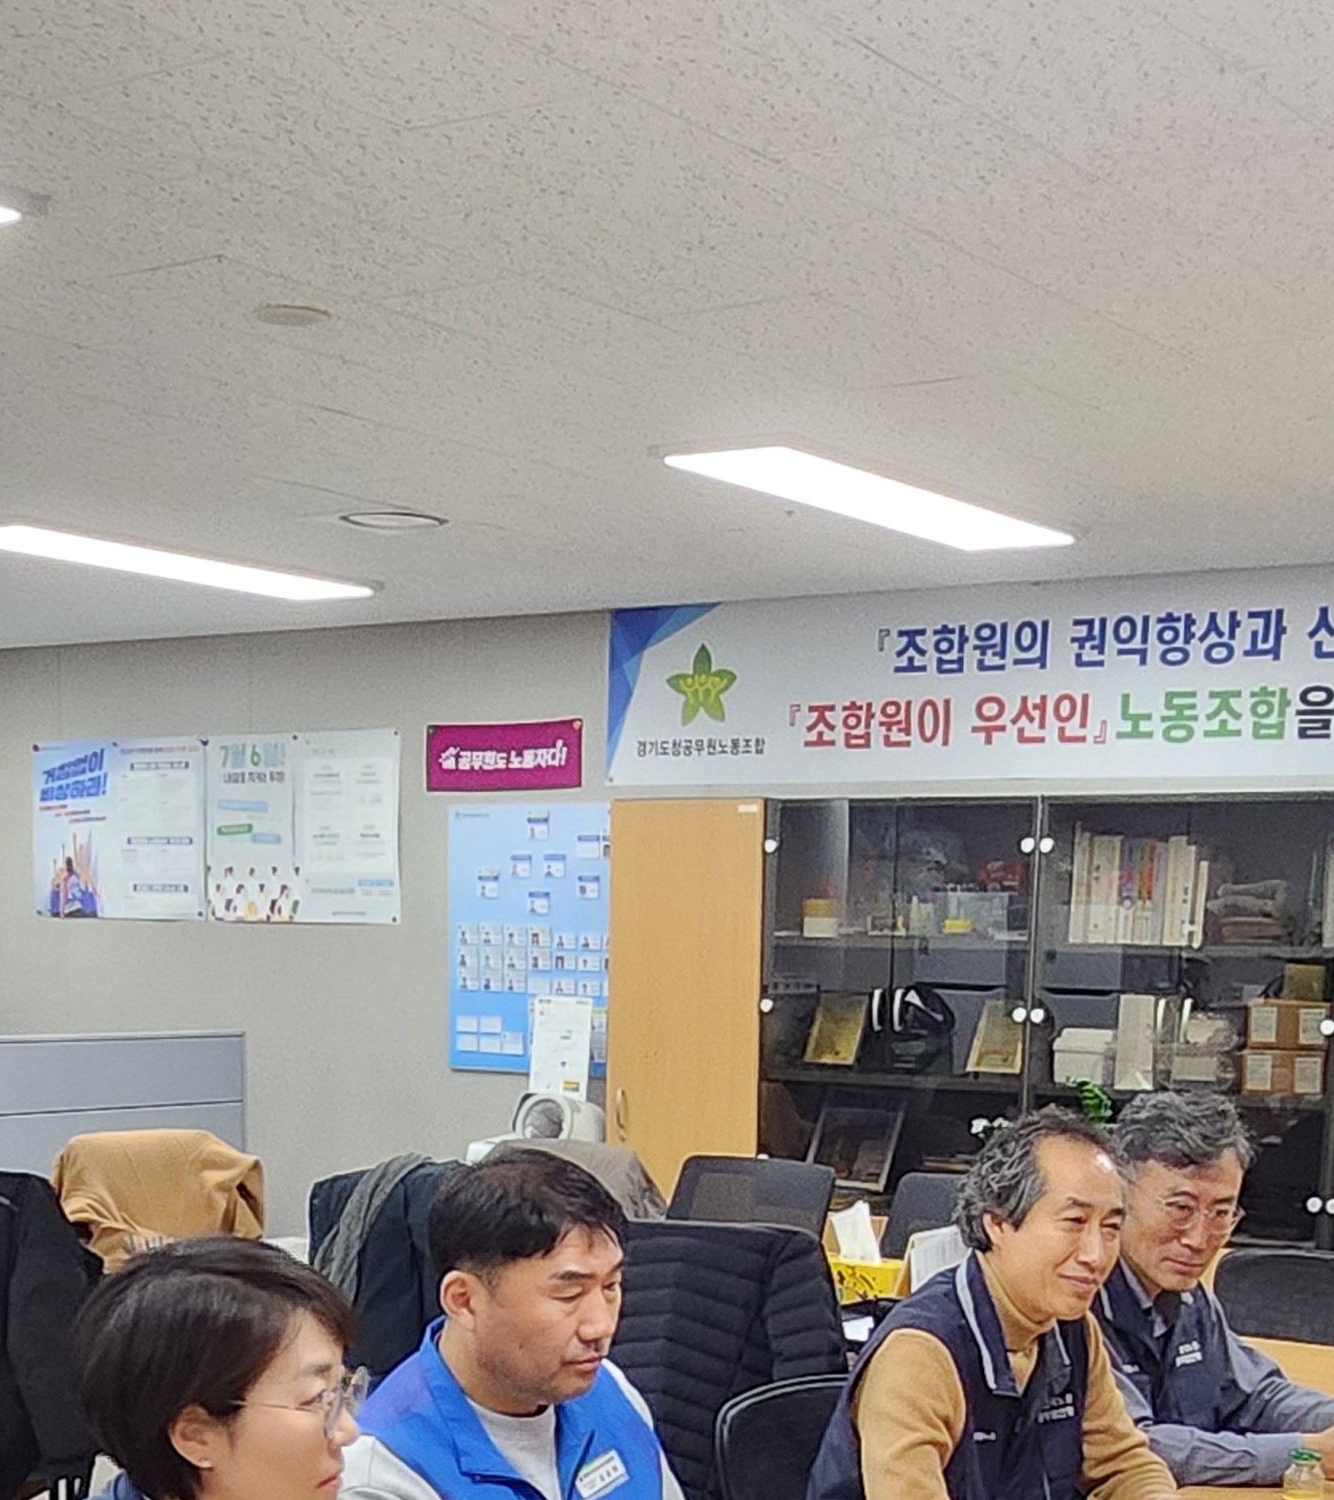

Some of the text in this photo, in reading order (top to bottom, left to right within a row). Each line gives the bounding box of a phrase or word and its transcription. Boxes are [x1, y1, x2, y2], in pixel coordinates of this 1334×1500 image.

[876, 615, 1050, 677] 『조합원의
[1068, 608, 1287, 673] 권익향상과
[636, 738, 766, 758] 경기도청공무원노동조합
[786, 693, 953, 752] 『조합원이
